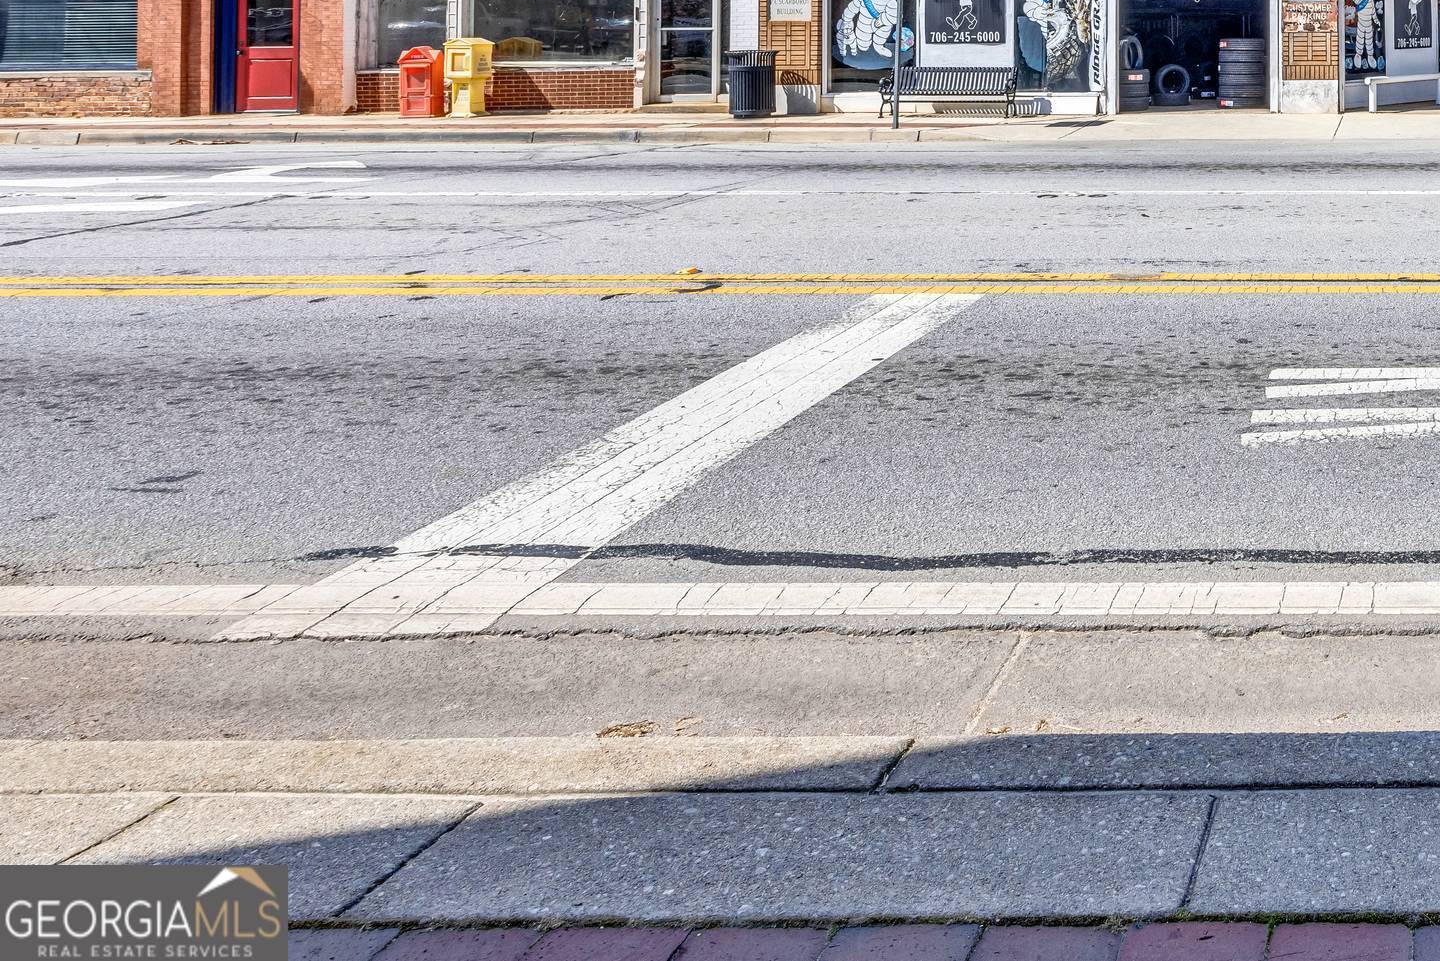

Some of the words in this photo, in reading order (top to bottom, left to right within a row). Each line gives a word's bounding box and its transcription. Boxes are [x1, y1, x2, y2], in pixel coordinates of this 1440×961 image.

[1287, 3, 1332, 12] CUSTOMER
[1291, 12, 1327, 20] PARKING
[930, 32, 1000, 42] 706-245-6000
[1092, 35, 1101, 85] RIDGE
